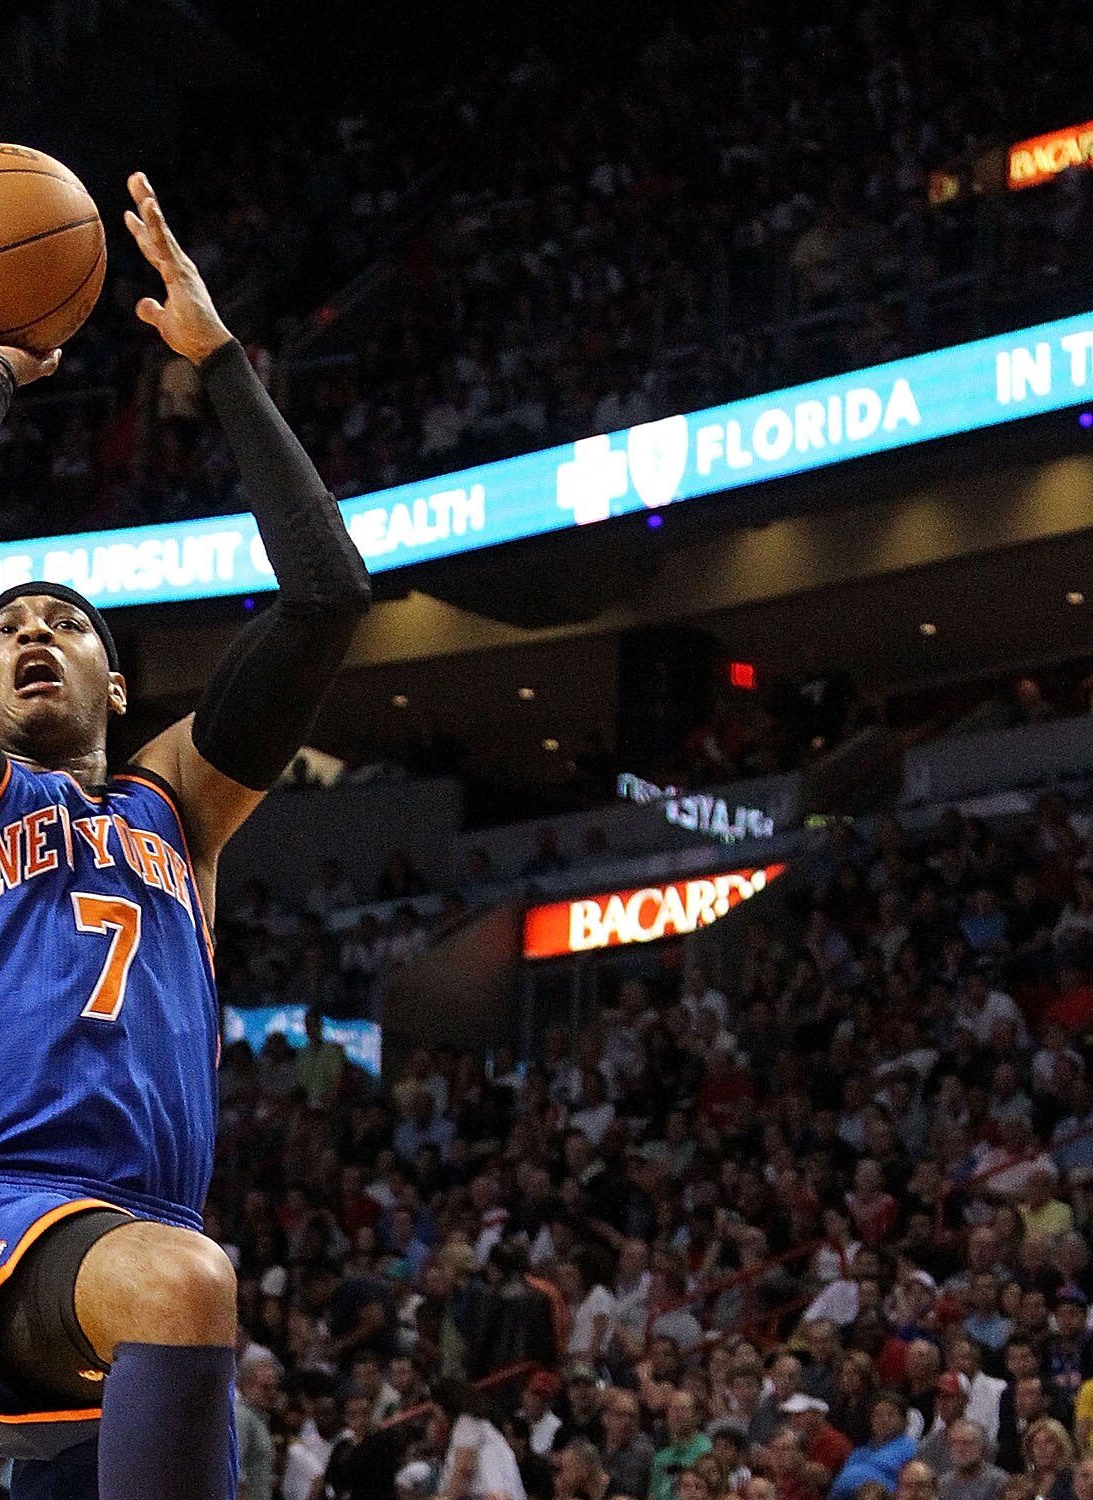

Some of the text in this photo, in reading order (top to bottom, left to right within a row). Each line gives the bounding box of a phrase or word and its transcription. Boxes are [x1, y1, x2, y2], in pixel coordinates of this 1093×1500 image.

[996, 342, 1052, 404] IN
[695, 379, 921, 475] FLORIDA
[44, 530, 243, 594] PURSUIT
[70, 891, 142, 1022] 7
